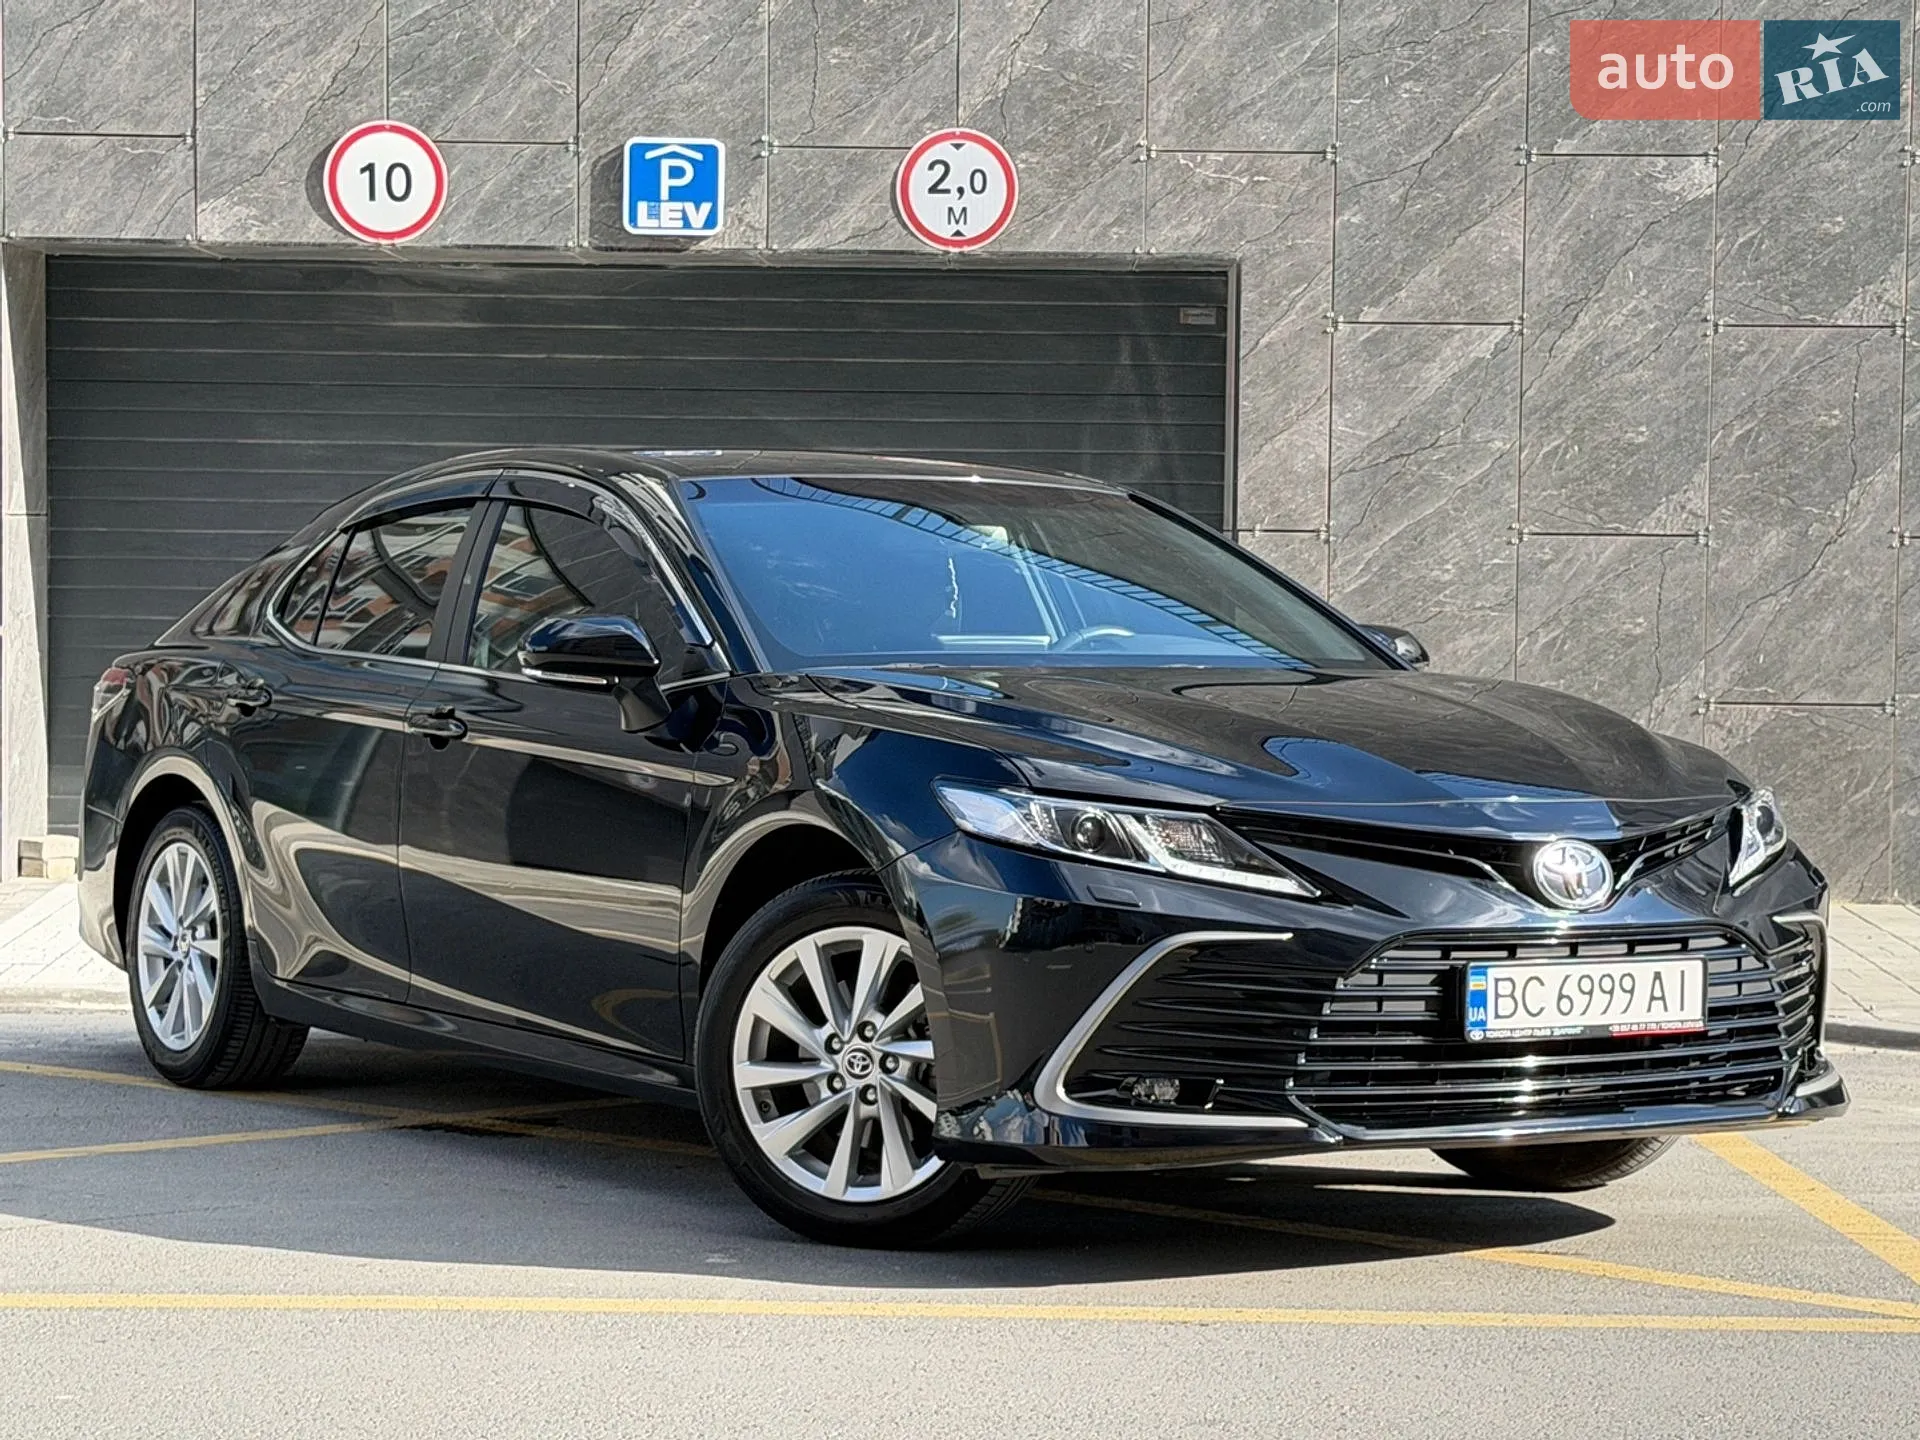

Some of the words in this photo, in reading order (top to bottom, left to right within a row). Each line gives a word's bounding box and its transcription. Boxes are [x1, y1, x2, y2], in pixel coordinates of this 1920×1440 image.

[359, 162, 412, 202] 10
[661, 159, 695, 200] P
[927, 159, 988, 200] 2,0
[637, 201, 713, 228] LEV
[1469, 1006, 1487, 1021] UA
[1493, 976, 1546, 1020] BC
[1556, 972, 1636, 1016] 6999
[1647, 970, 1686, 1013] AI
